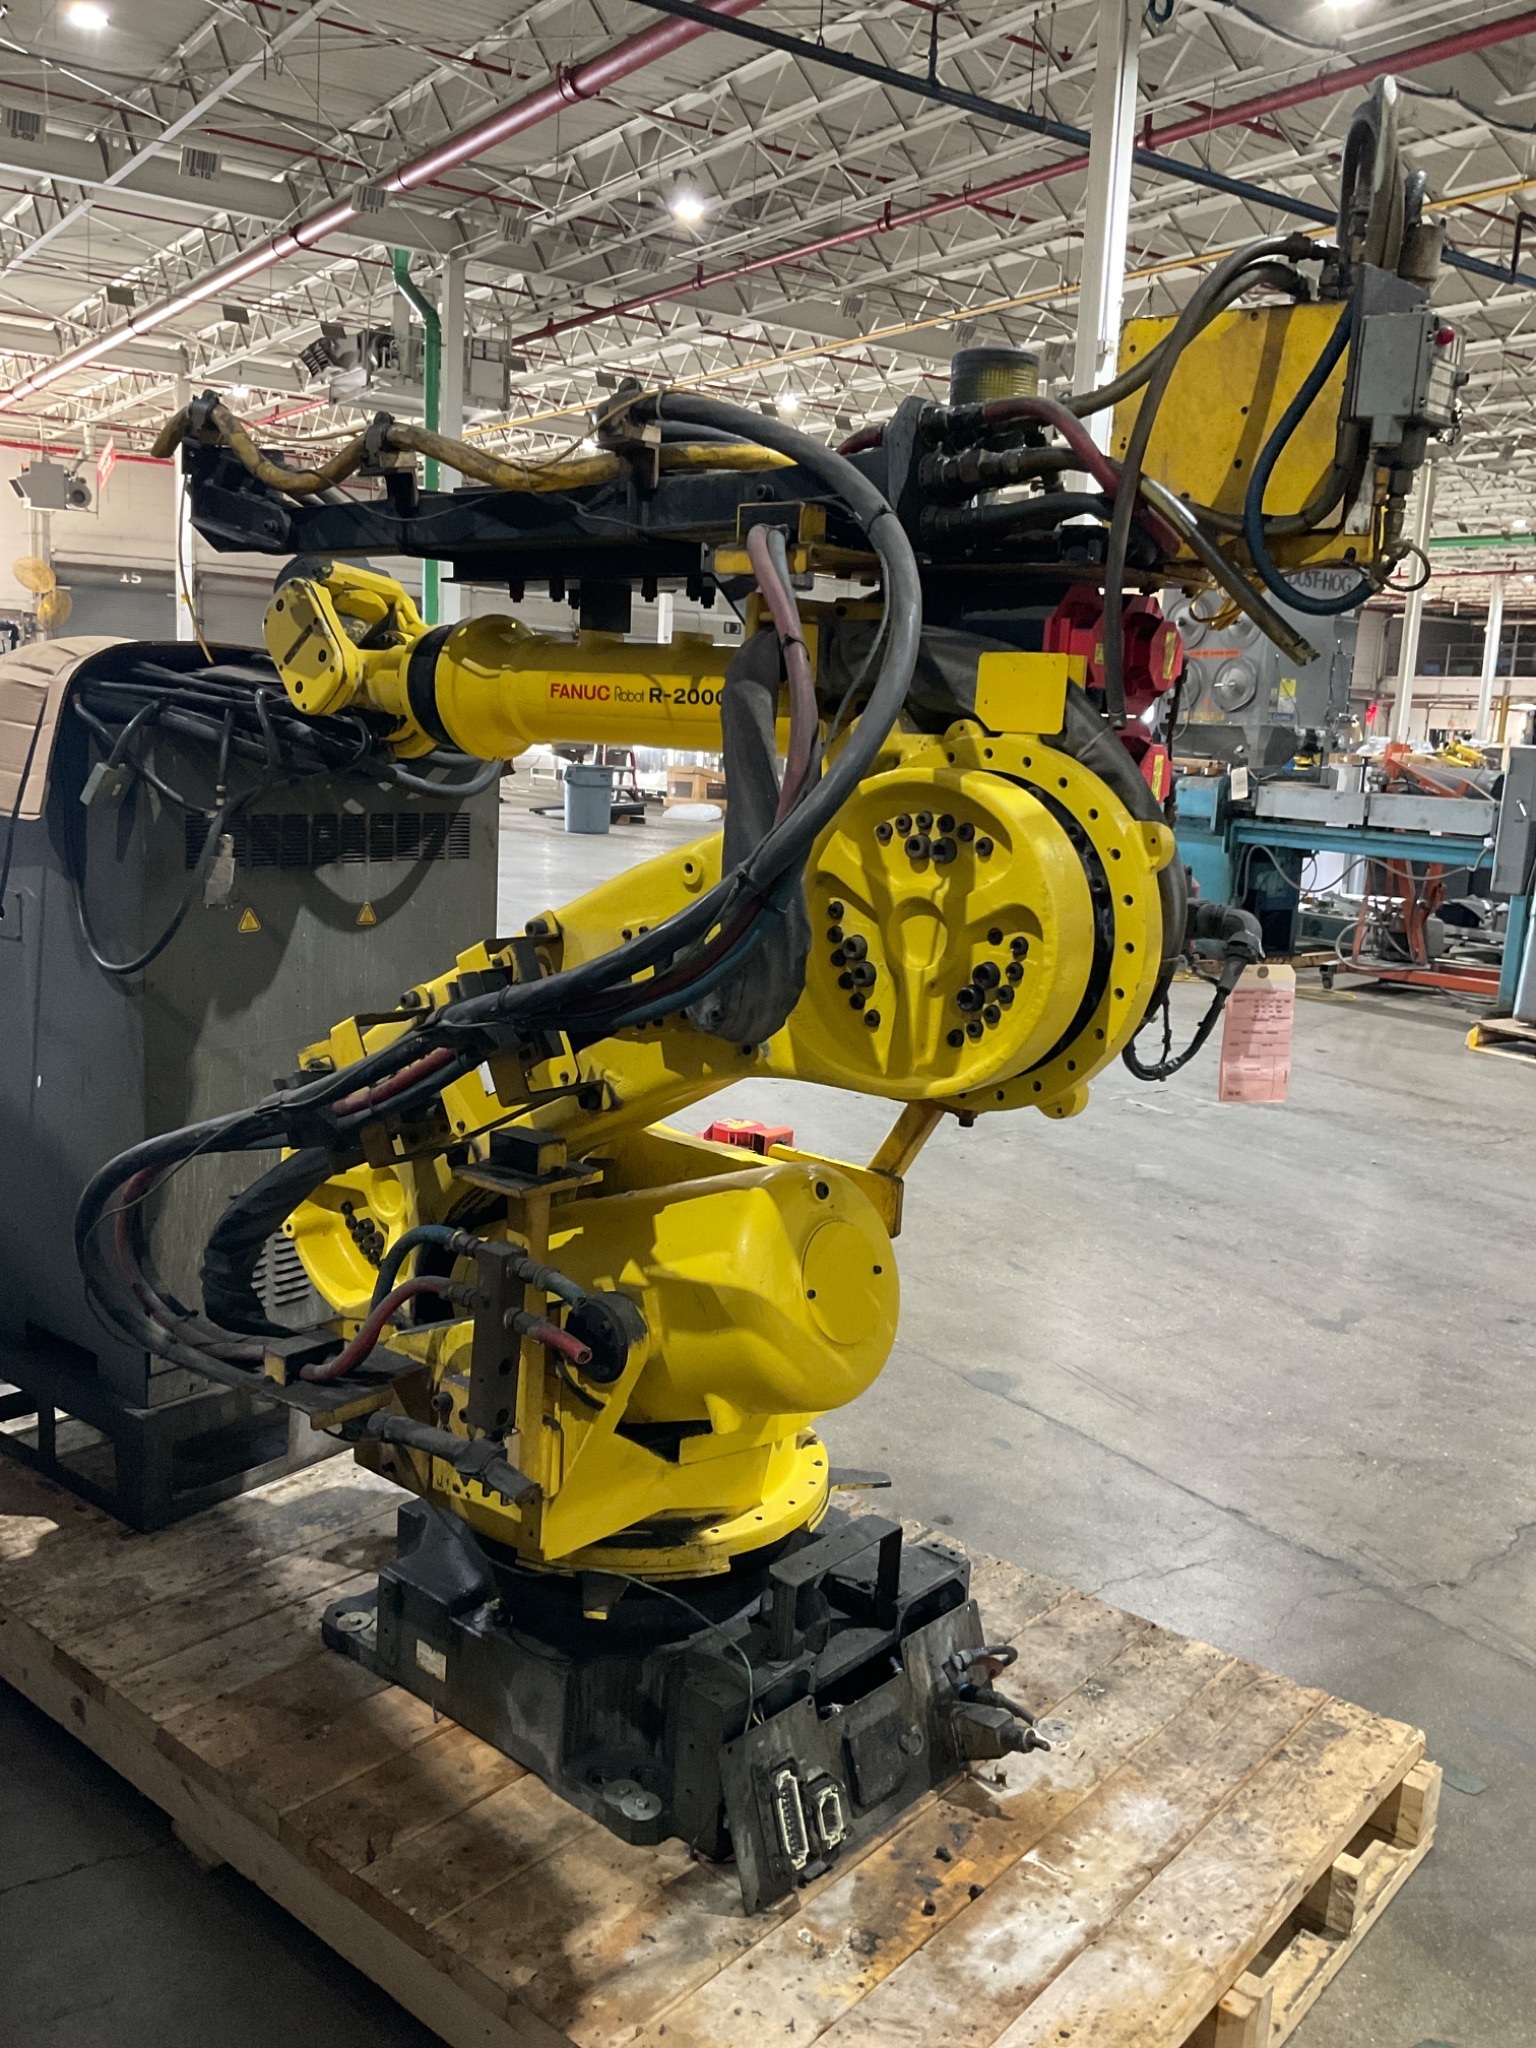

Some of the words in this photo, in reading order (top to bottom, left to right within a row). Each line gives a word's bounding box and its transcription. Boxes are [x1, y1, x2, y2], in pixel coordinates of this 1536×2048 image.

[189, 168, 211, 180] S-10
[119, 571, 142, 584] 15
[550, 683, 611, 701] FANUC
[614, 686, 645, 702] Robot
